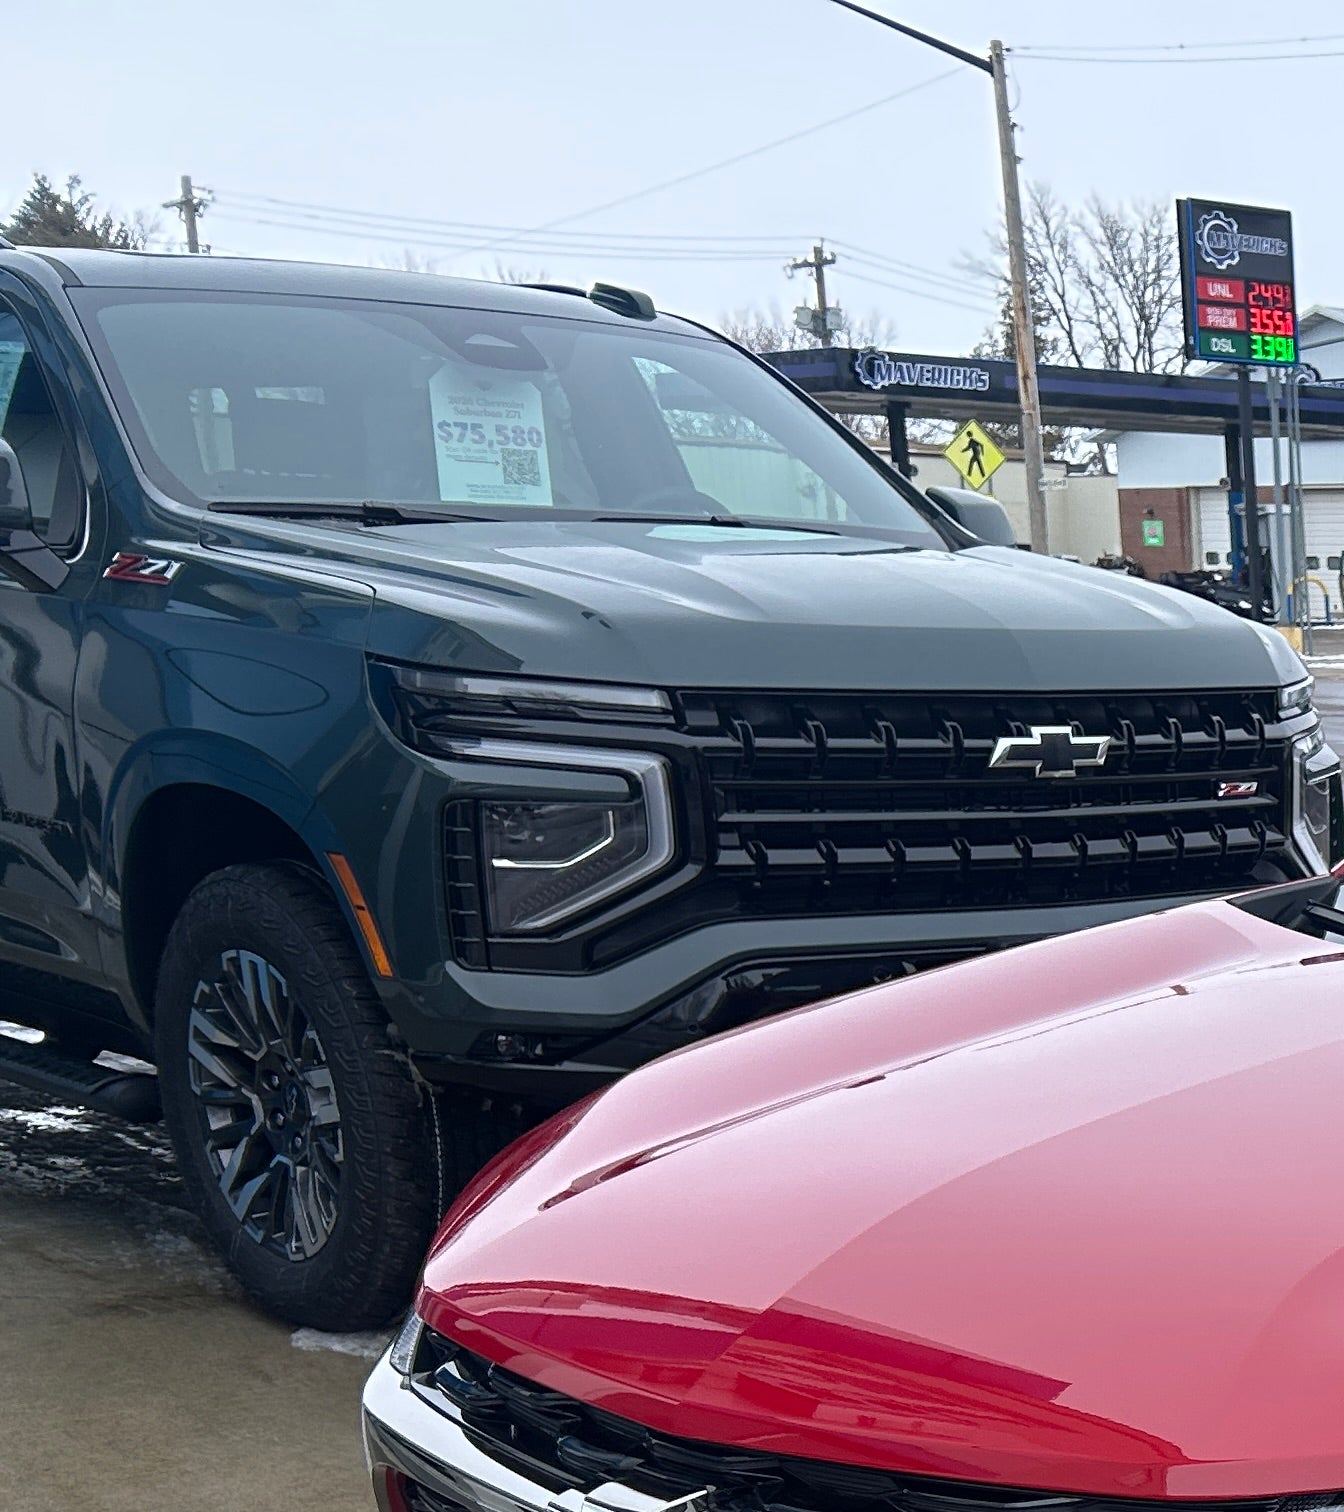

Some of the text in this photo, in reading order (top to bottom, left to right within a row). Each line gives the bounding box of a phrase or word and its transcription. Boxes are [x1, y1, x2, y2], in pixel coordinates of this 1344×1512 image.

[1206, 282, 1234, 298] UNL
[1210, 338, 1236, 353] DSL
[437, 420, 543, 449] $75,580
[102, 552, 185, 585] Z71
